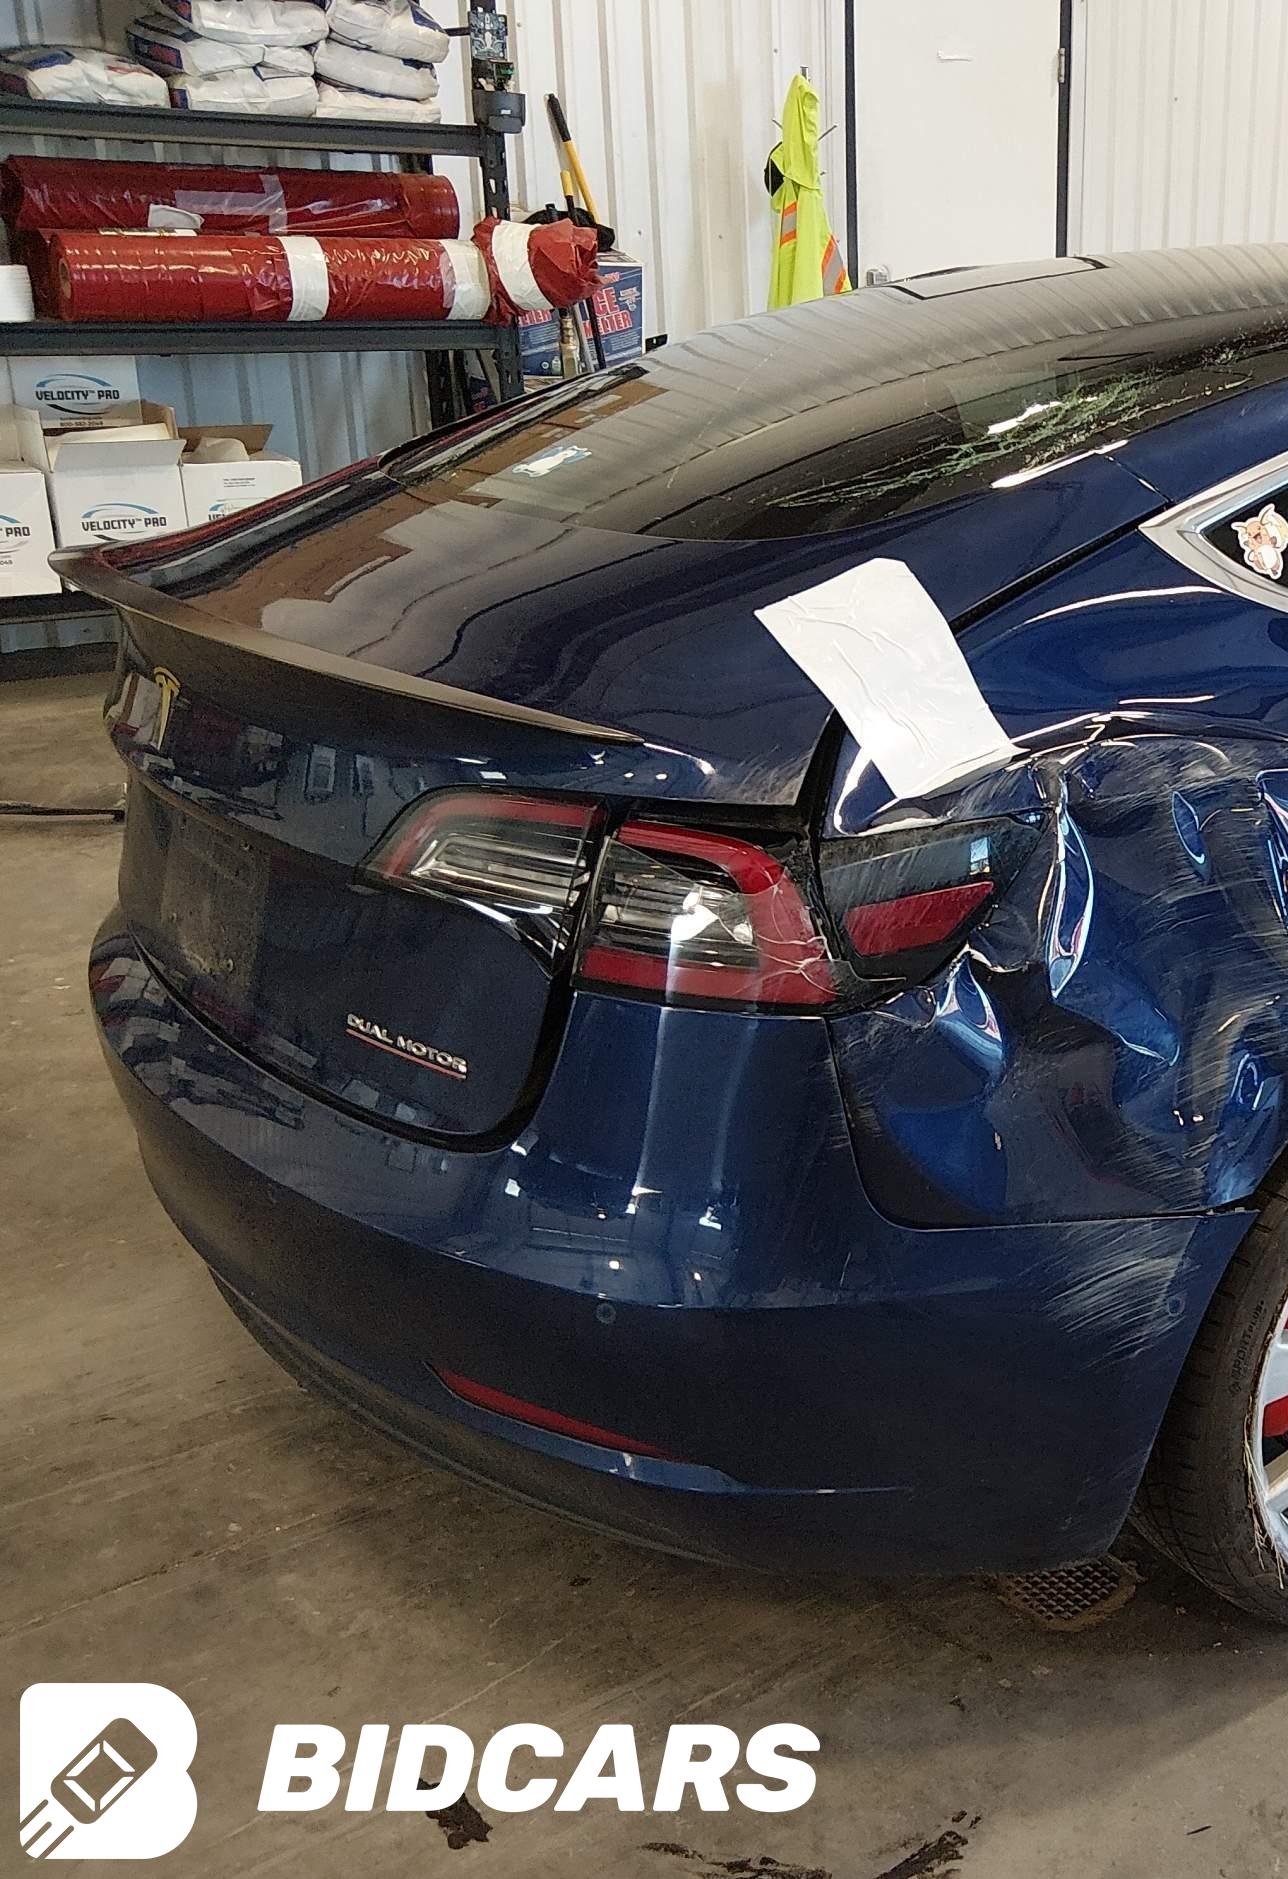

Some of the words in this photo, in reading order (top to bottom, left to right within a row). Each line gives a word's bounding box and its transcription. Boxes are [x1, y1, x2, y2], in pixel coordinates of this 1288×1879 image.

[97, 389, 120, 400] PRO
[144, 516, 167, 528] PRO
[5, 526, 31, 537] PRO
[347, 1013, 394, 1044] DUAL
[396, 1035, 468, 1073] MOTOR
